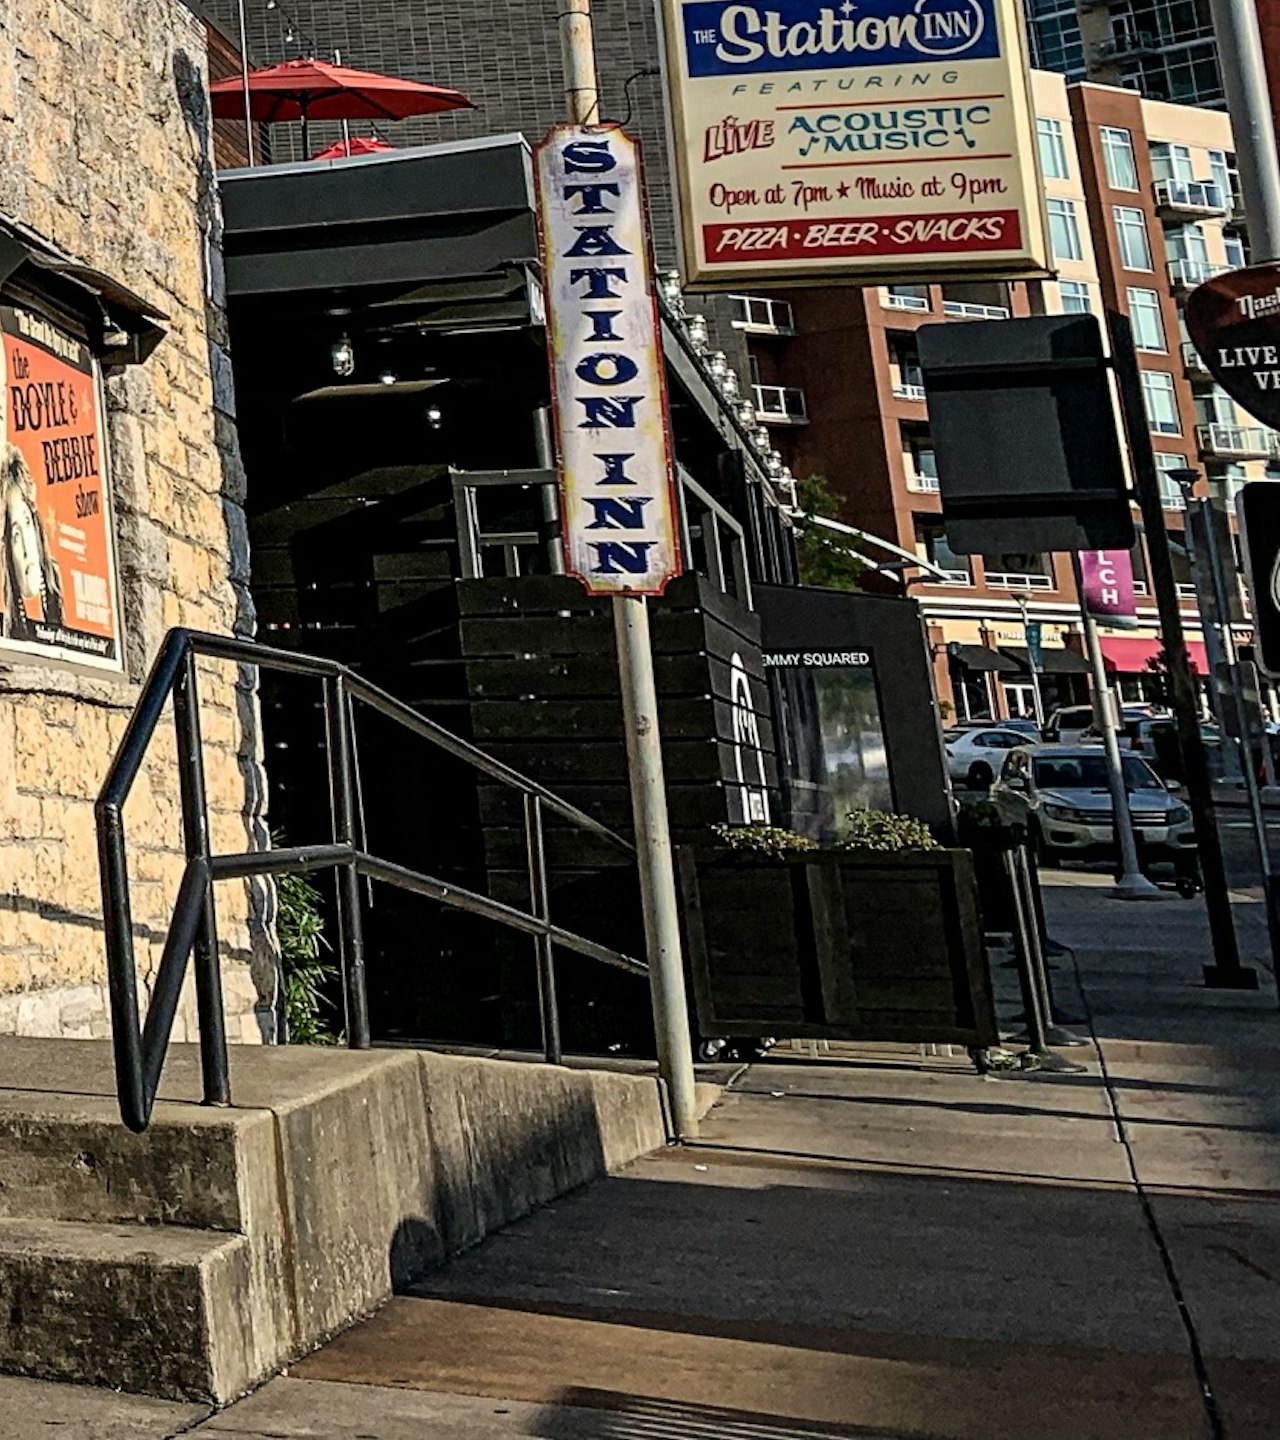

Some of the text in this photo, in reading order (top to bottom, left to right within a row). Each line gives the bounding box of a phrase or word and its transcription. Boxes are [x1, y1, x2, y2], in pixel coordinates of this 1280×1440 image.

[693, 3, 971, 63] THE Station INN
[732, 71, 959, 96] FEATURING
[789, 105, 991, 134] ACOUSTIC
[823, 129, 950, 153] MUSIC
[709, 172, 1008, 214] Open at 7pm Music at 9pm
[716, 216, 1007, 253] PIZZA BEER SNACKS
[562, 140, 646, 429] STATION
[12, 348, 30, 380] the
[1218, 345, 1278, 367] LIVE
[10, 380, 78, 432] DOYLE &
[41, 433, 99, 486] DEBBIE
[75, 483, 100, 519] show
[582, 452, 659, 575] INN
[803, 652, 869, 666] SQUARED
